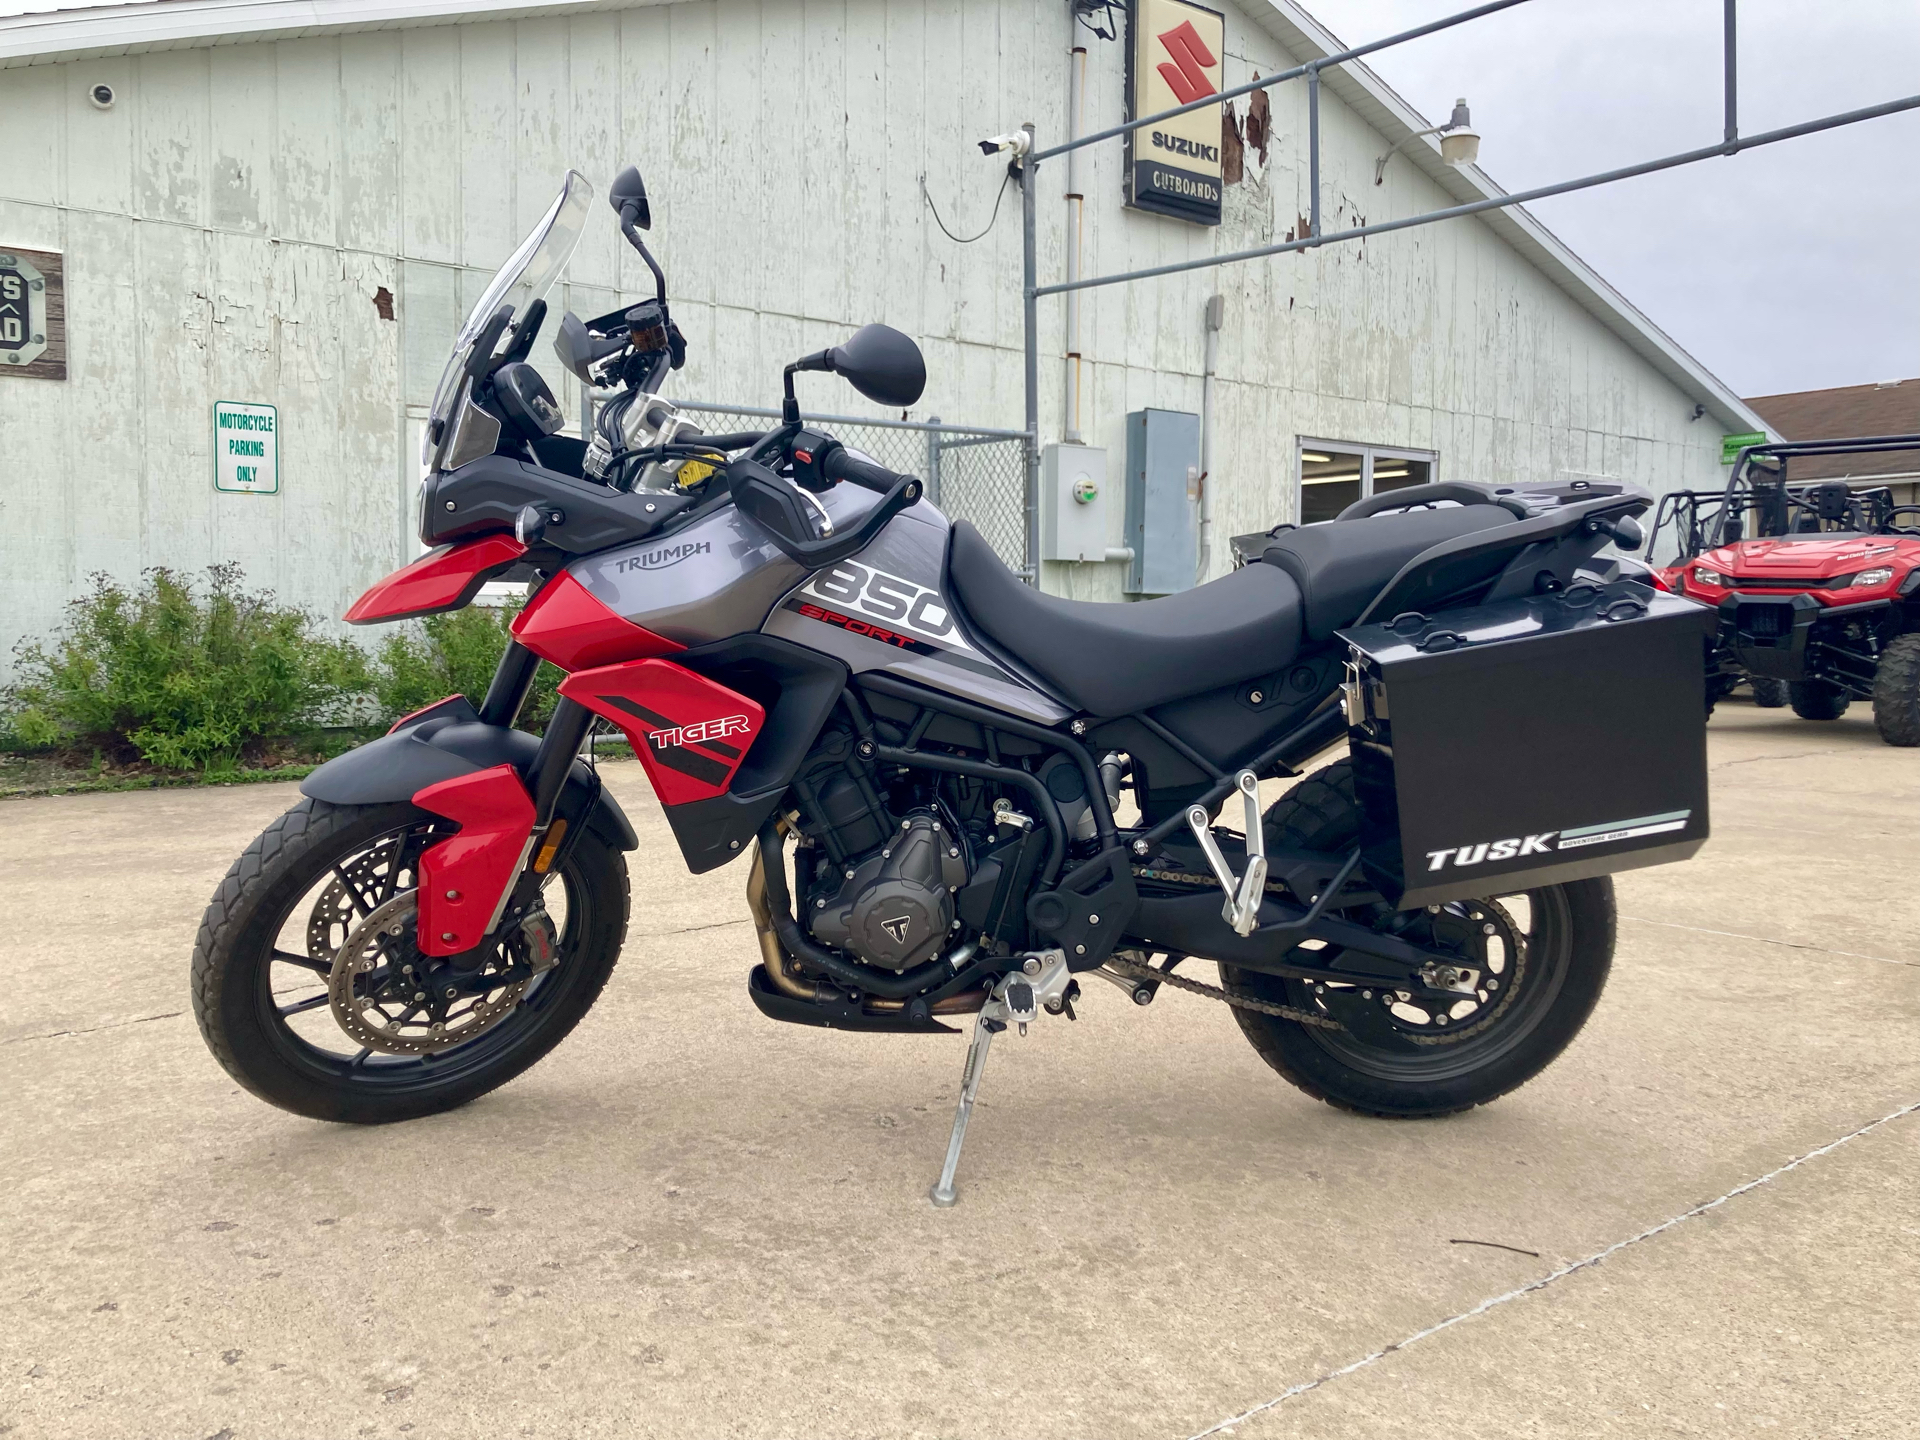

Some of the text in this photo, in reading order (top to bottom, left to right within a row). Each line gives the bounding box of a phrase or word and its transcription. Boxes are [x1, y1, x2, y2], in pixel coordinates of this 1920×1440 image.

[1151, 131, 1219, 163] SUZUKI
[1153, 170, 1219, 201] OUTBOARDS
[0, 275, 21, 300] S
[219, 412, 273, 432] MOTORCYCLE
[229, 438, 264, 457] PARKING
[236, 465, 257, 482] ONLY
[615, 541, 711, 574] TRIUMPH
[813, 562, 956, 638] 850
[798, 602, 916, 648] SPORT
[649, 714, 752, 749] TIGER
[1426, 831, 1560, 871] TUSK
